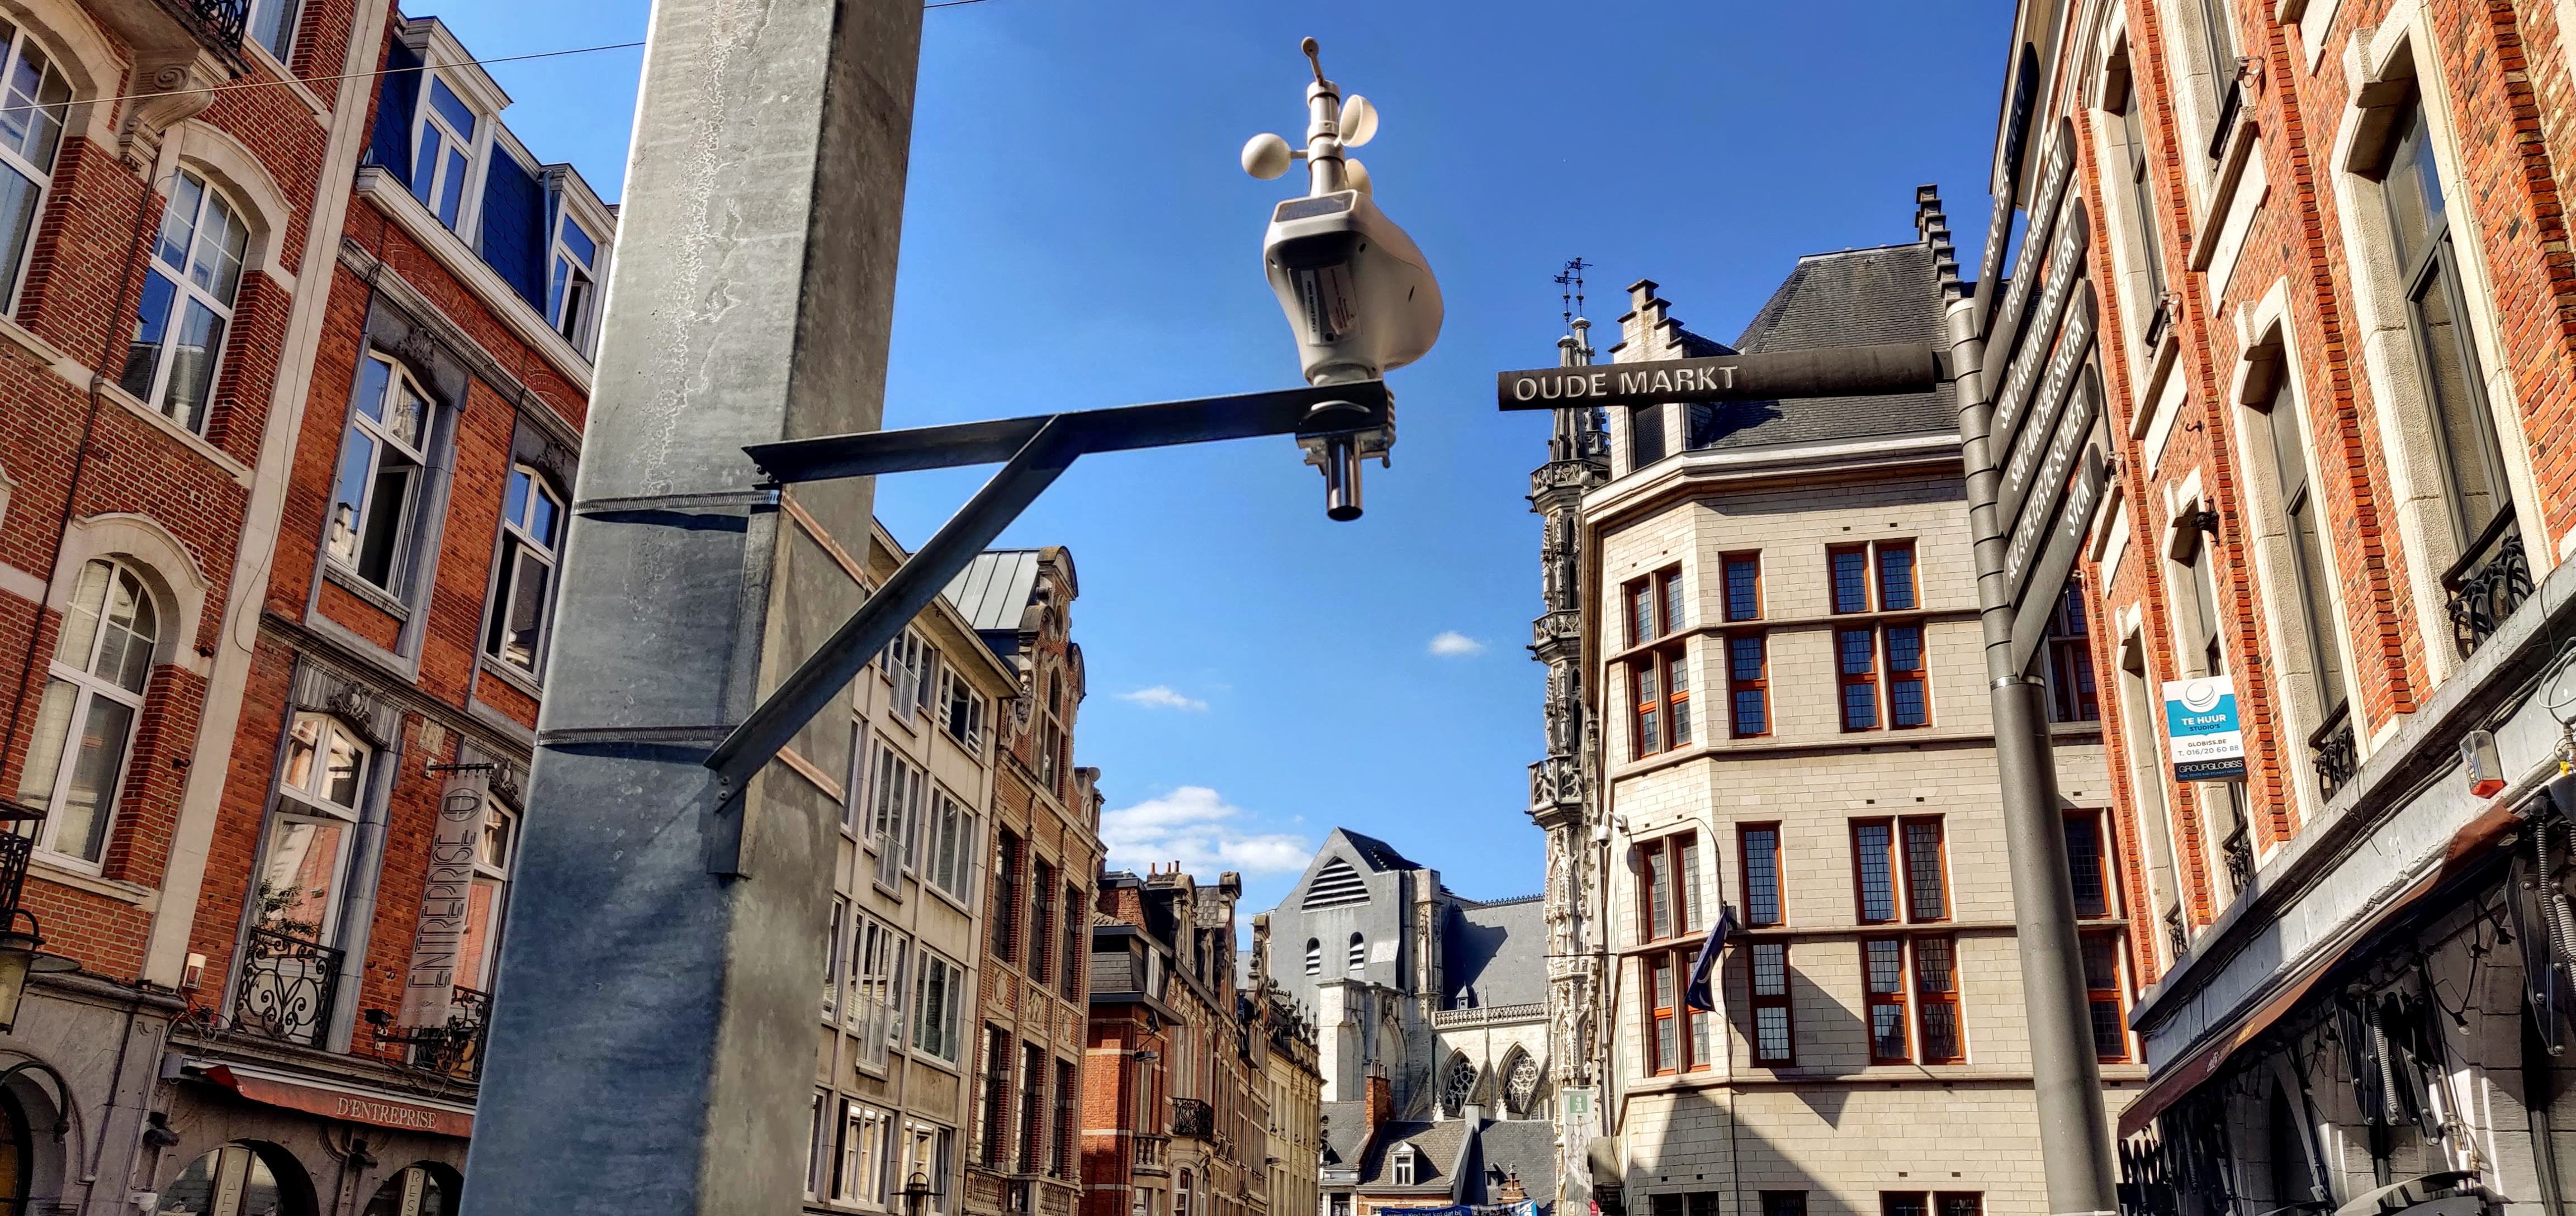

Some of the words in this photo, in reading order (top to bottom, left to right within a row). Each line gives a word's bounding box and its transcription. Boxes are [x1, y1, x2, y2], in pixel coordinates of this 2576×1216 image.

[1985, 205, 2001, 277] GROOT
[2006, 249, 2028, 322] PATER
[2026, 141, 2063, 264] DAMIAAN
[2001, 220, 2076, 429] SINT-KWINTENSKERK
[1513, 372, 1607, 401] OUDE
[1618, 364, 1738, 395] MARKT
[2011, 304, 2085, 492] SINT-MICHIELSKERK
[2008, 530, 2025, 585] AULA
[2023, 478, 2047, 547] PIETER
[2044, 455, 2057, 498] DE
[2054, 388, 2085, 473] SOMER
[2068, 466, 2090, 537] STUK
[2187, 739, 2227, 748] GLOBISS.BE
[2197, 714, 2227, 724] HUUR
[2179, 760, 2243, 773] GROUPGLOBISS
[2186, 747, 2214, 756] 016/20
[408, 829, 477, 988] ENTREPRISE
[336, 1097, 437, 1129] D'ENTREPRISE
[406, 1170, 420, 1216] RES
